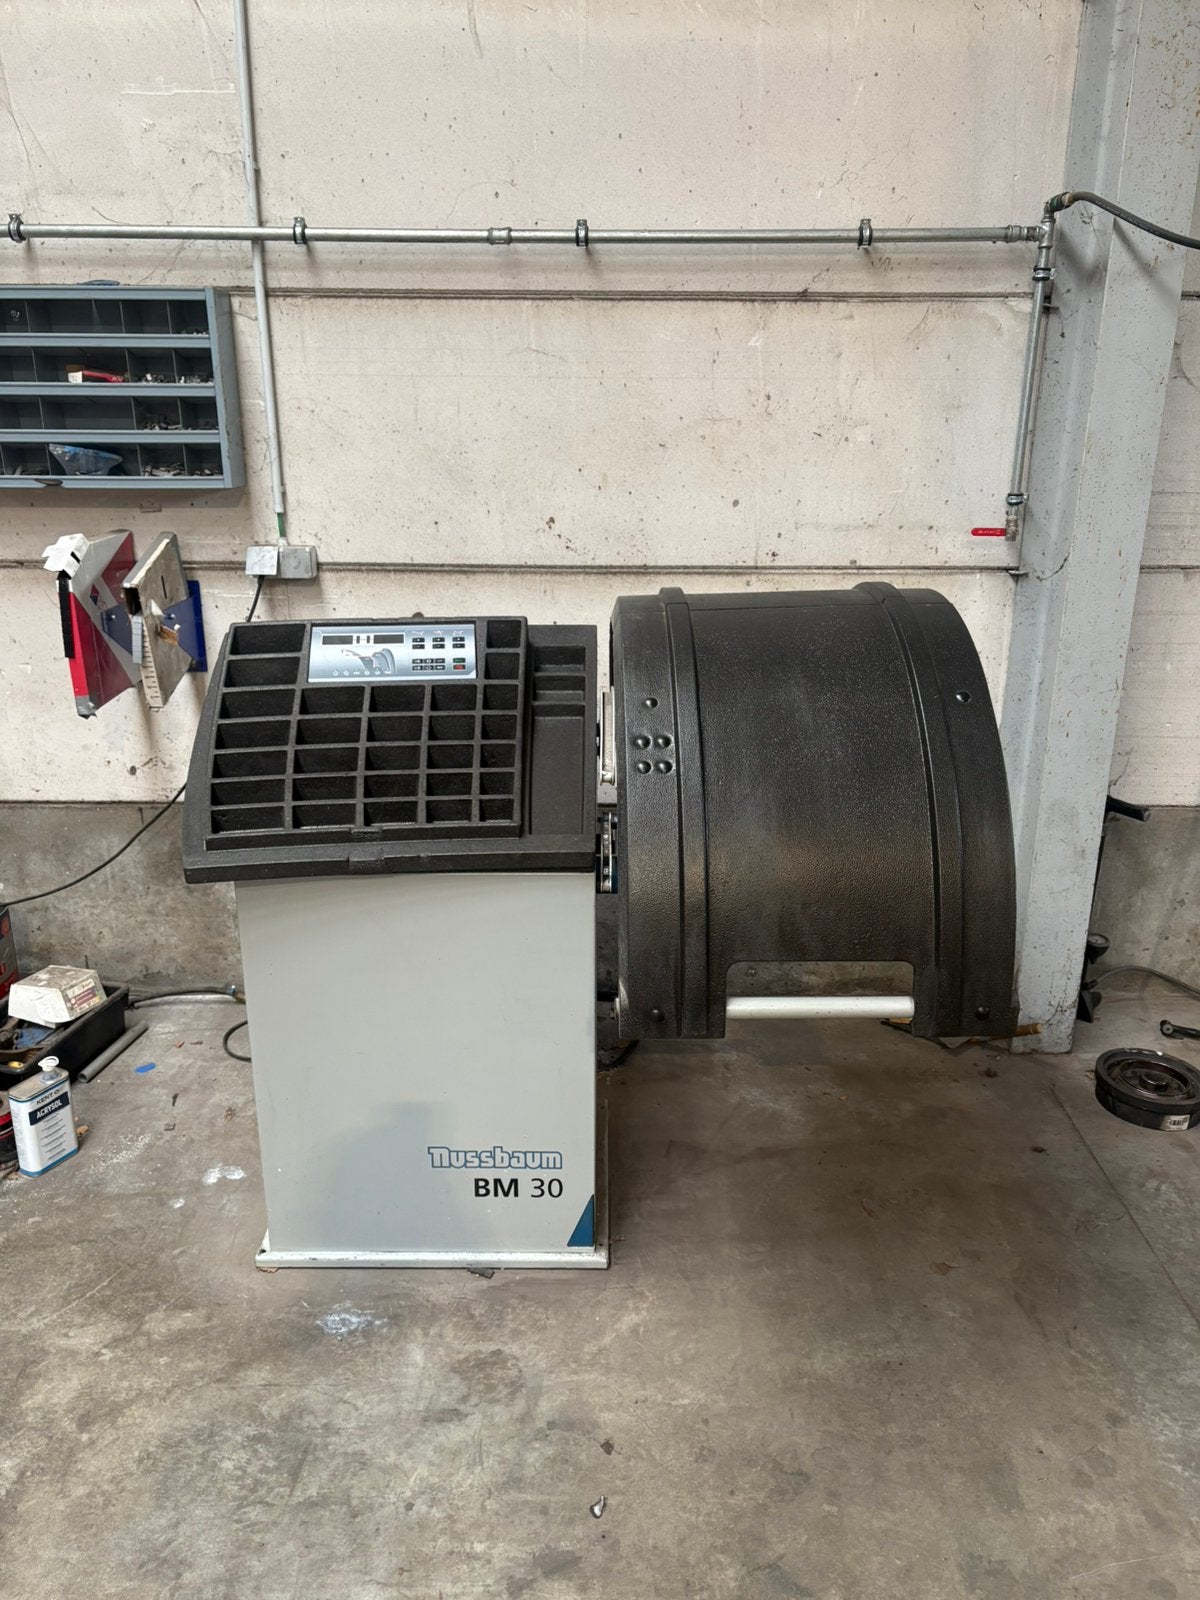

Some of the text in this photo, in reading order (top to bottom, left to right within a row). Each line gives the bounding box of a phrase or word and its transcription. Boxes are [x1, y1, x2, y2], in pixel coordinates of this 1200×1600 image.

[36, 1098, 63, 1119] ACRYSOL
[474, 1178, 563, 1198] BM 30
